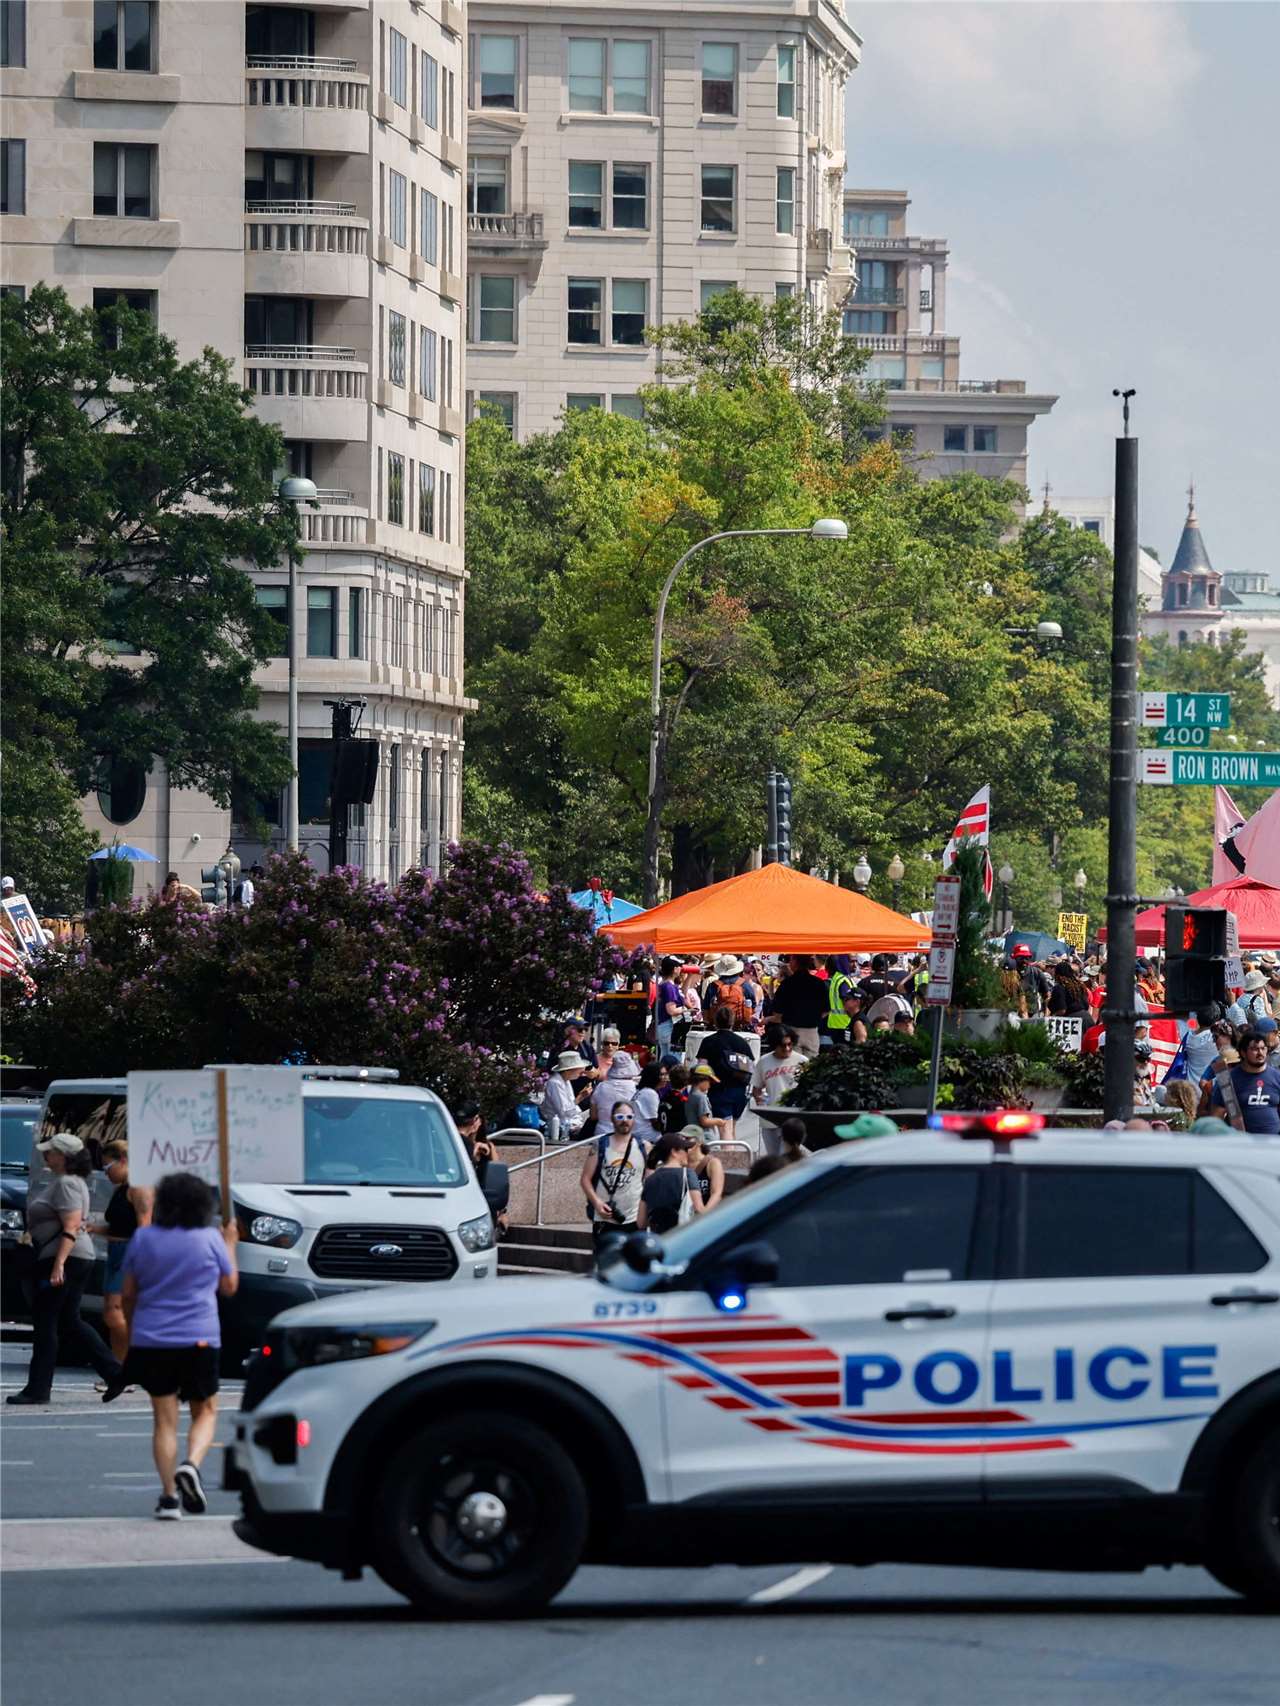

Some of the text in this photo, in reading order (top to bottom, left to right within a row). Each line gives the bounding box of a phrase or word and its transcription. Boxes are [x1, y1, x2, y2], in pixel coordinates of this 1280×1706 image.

[1176, 698, 1196, 723] 14
[1208, 699, 1221, 710] ST
[1207, 712, 1222, 723] NW
[1163, 727, 1204, 744] 400
[1178, 755, 1205, 779] RON
[1212, 756, 1258, 781] BROWN
[1048, 1019, 1079, 1035] FREE
[844, 1344, 1220, 1408] POLICE
